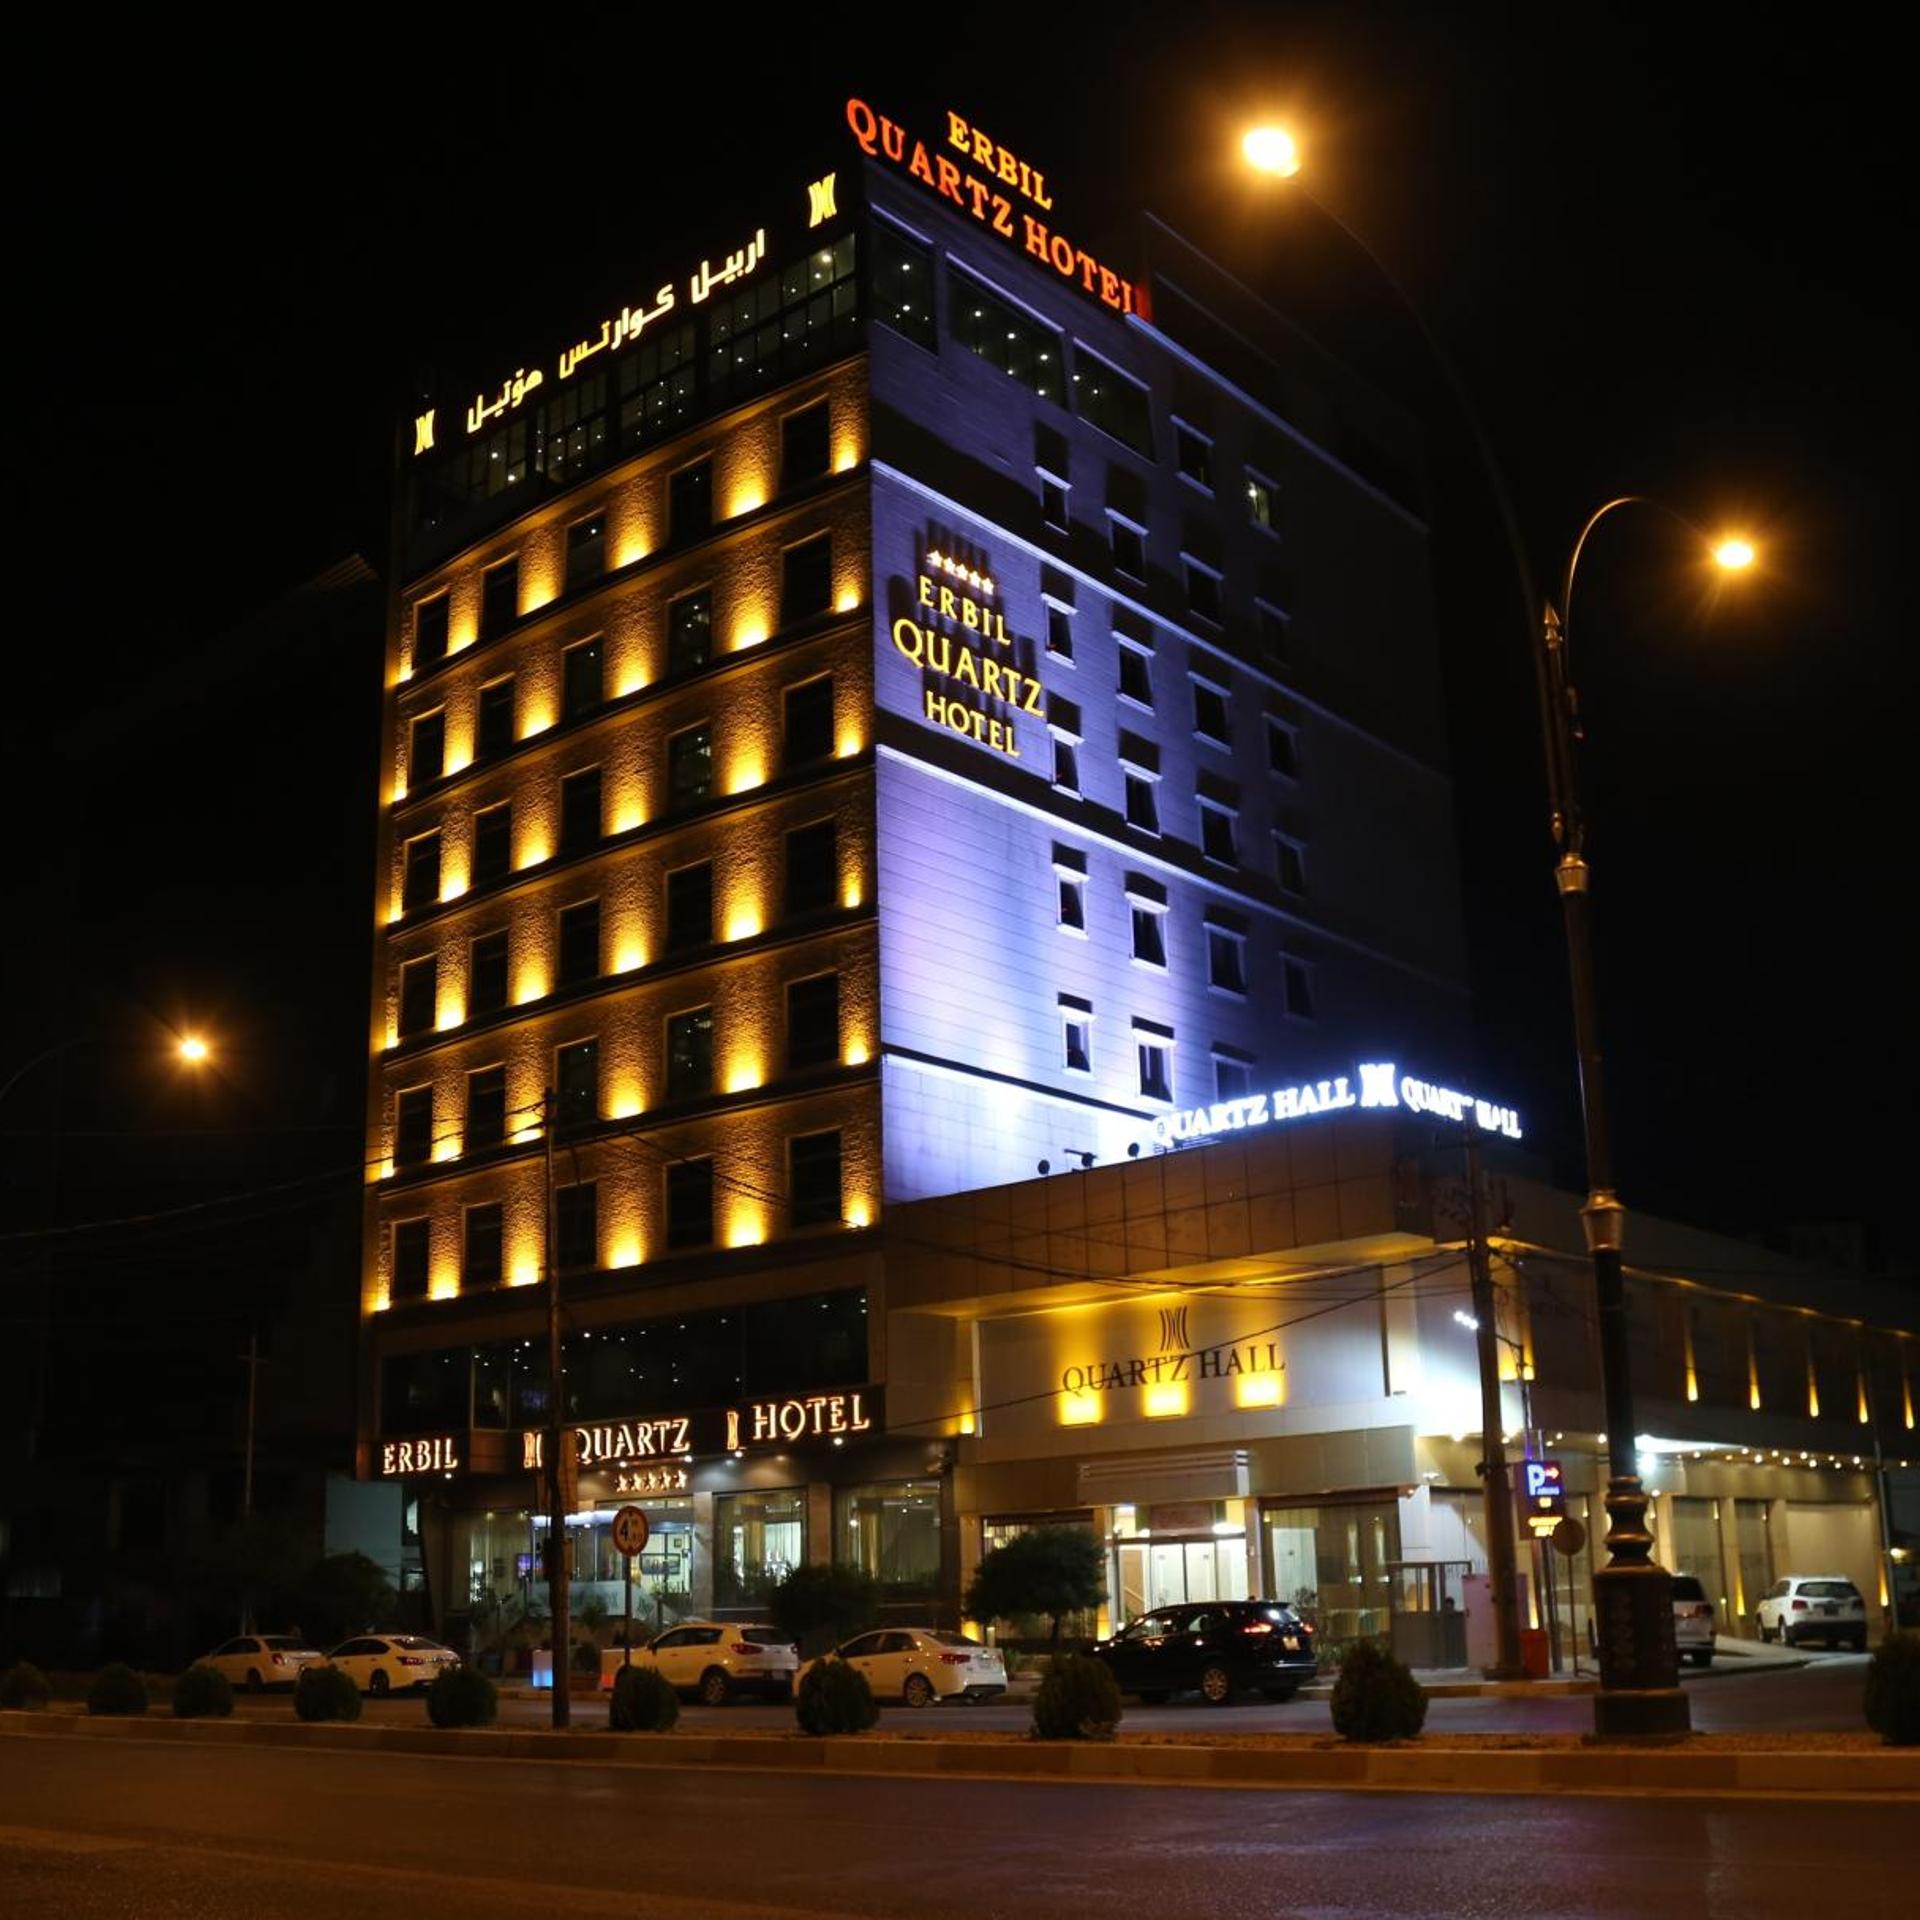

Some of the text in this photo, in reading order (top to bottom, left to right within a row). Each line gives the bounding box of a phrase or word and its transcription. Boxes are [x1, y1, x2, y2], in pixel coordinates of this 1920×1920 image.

[846, 98, 1014, 238] QUARTZ
[948, 111, 1053, 210] ERBIL
[919, 574, 1011, 647] ERBIL
[893, 618, 1045, 717] QUARTZ
[925, 690, 1021, 758] HOTEL
[1152, 1077, 1356, 1149] QUARTZ HALL
[1063, 1344, 1286, 1397] QUARTZ HALL
[382, 1393, 870, 1475] ERBIL QUARTZ HOTEL
